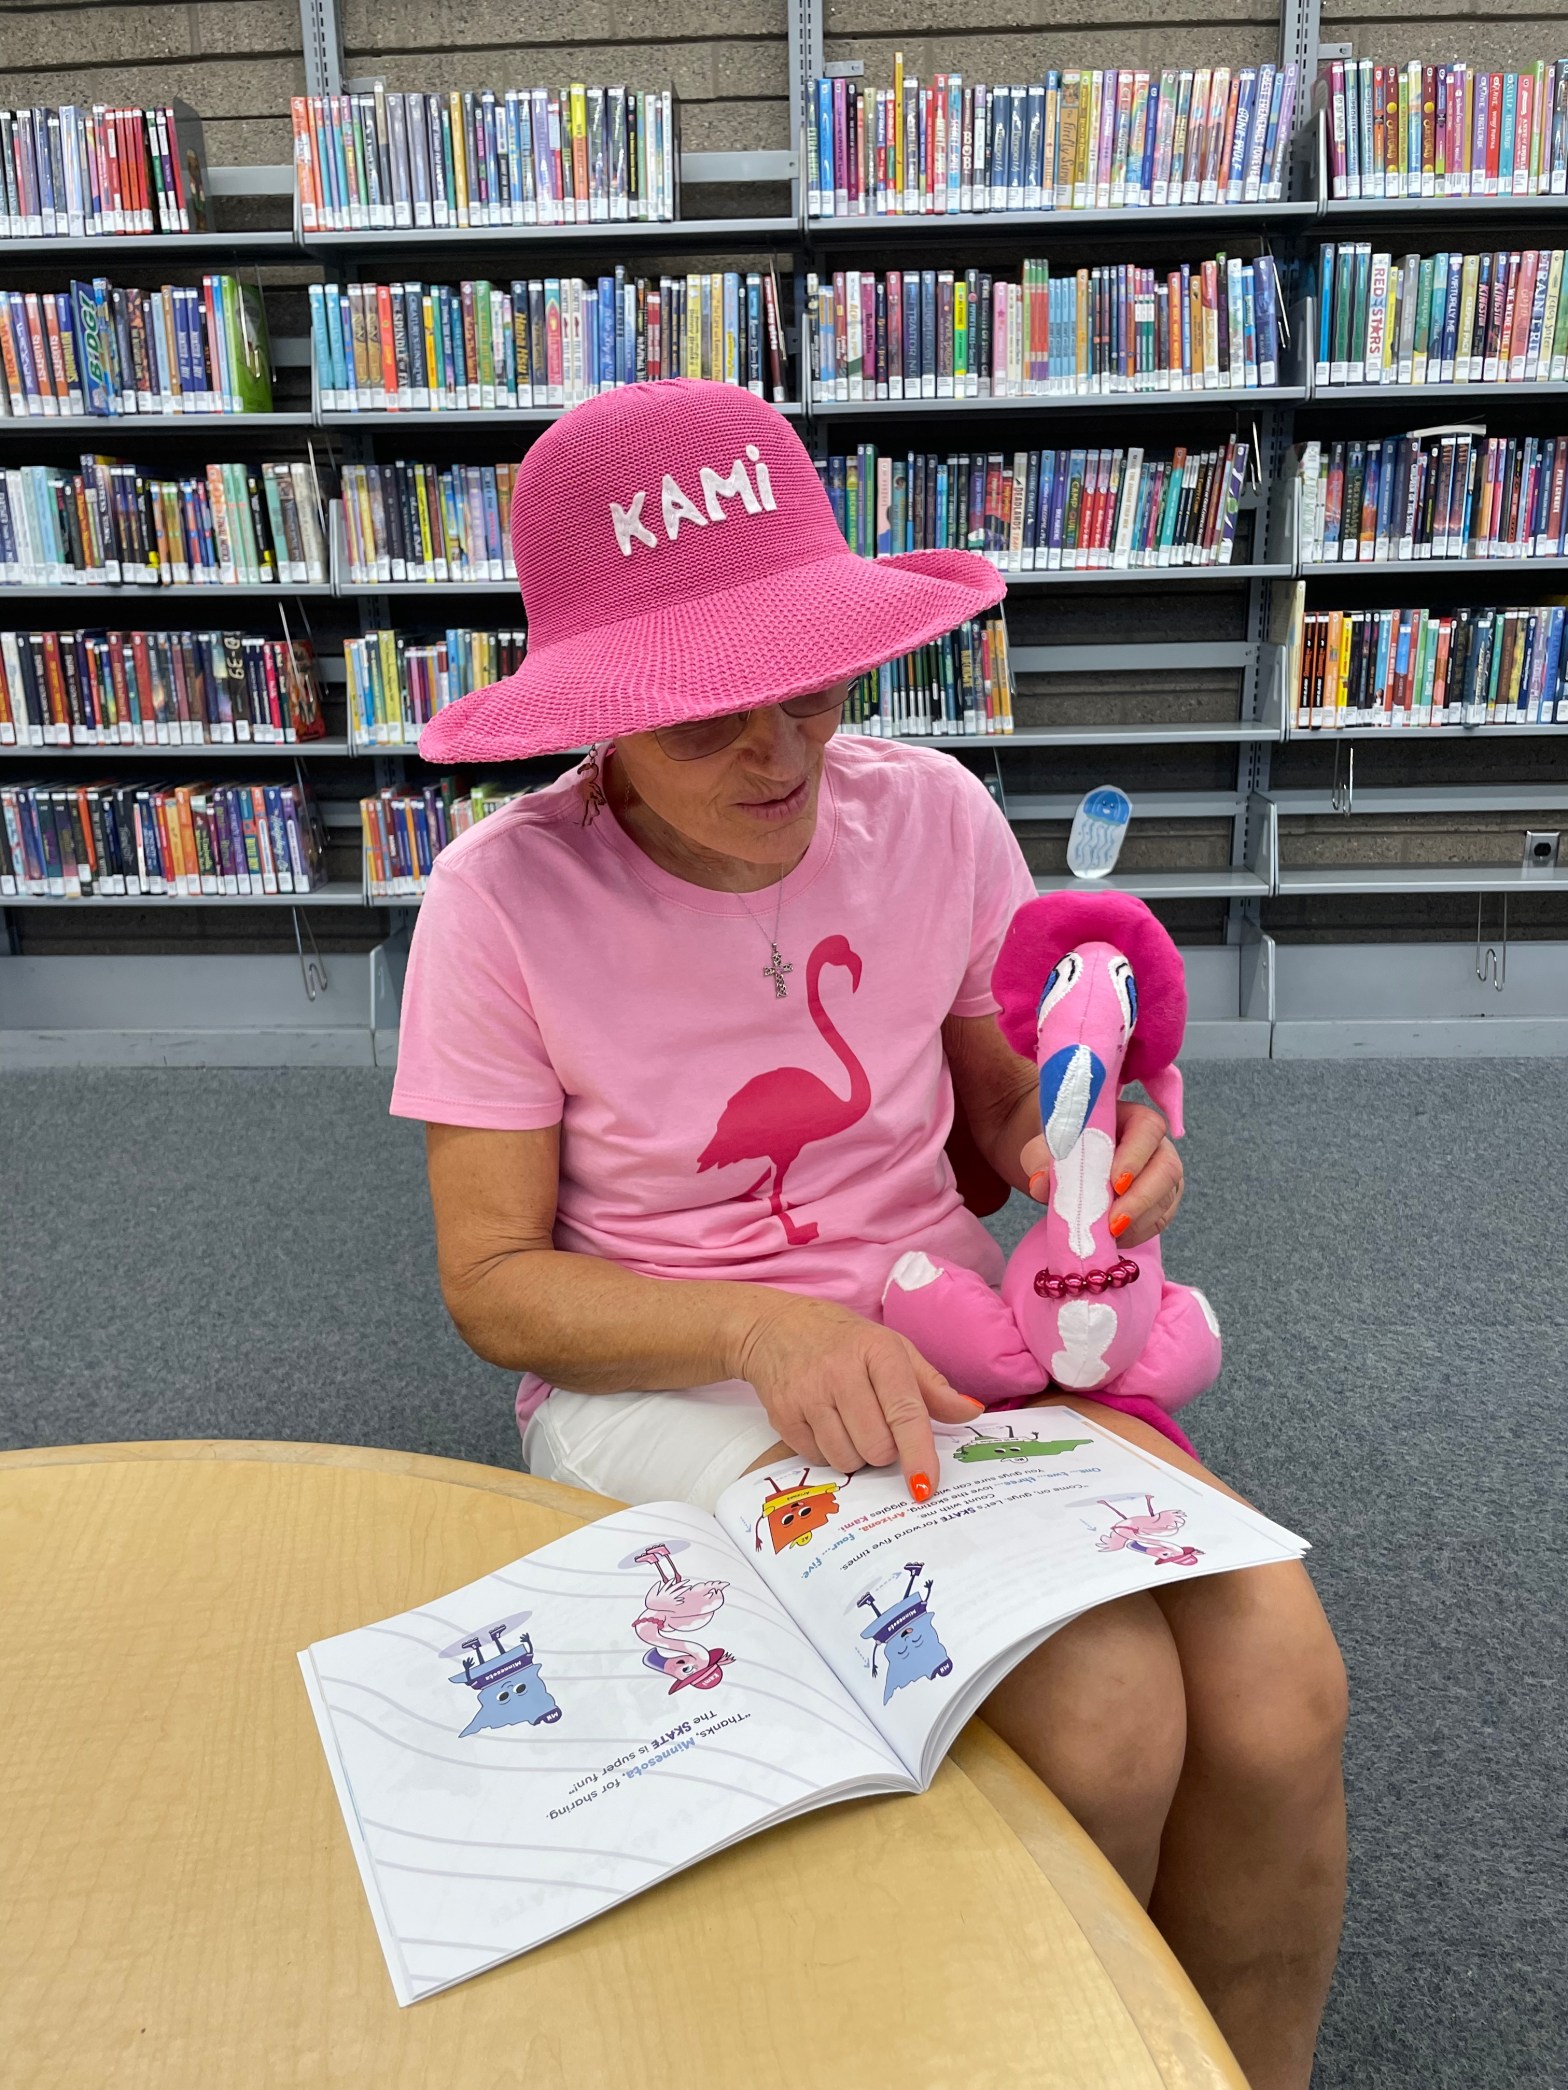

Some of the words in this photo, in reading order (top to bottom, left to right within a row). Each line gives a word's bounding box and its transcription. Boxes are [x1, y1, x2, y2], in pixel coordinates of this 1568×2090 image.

[1260, 76, 1272, 97] BEST
[1235, 108, 1249, 139] GONE
[1255, 99, 1269, 143] FRENEMIES
[1061, 122, 1076, 155] Firefly
[1232, 140, 1245, 171] WOLF
[1251, 146, 1262, 176] FOREVE
[1060, 157, 1074, 185] Summ
[1373, 268, 1385, 297] RED
[1449, 275, 1459, 318] VIRTUALLY
[1478, 284, 1489, 327] KINGSTON
[1494, 283, 1504, 325] KINGSTON
[1507, 288, 1515, 302] WE
[1447, 320, 1455, 333] ME
[1504, 303, 1513, 327] WERE
[394, 313, 405, 361] SPINDLE
[515, 313, 526, 347] Hana
[907, 310, 917, 355] TRAITOR
[517, 349, 528, 373] Hsu
[399, 372, 408, 389] FA
[1070, 481, 1080, 508] CAMP
[1013, 487, 1023, 530] DEADLANDS
[1067, 512, 1078, 548] QUILTB
[224, 637, 245, 680] D-39
[973, 1475, 995, 1486] sure
[997, 1468, 1022, 1480] guys
[950, 1490, 969, 1502] the
[951, 1481, 971, 1492] can
[1003, 1489, 1032, 1503] guys.
[1032, 1488, 1050, 1496] on,
[868, 1499, 907, 1519] giggles
[905, 1496, 949, 1516] skating,
[938, 1501, 961, 1515] with
[962, 1491, 995, 1507] Count
[976, 1497, 1003, 1511] Let's
[836, 1514, 868, 1533] Kami.
[916, 1508, 937, 1520] me.
[938, 1505, 976, 1524] SKATE
[893, 1517, 938, 1540] forward
[871, 1536, 892, 1551] five
[838, 1547, 870, 1572] times.
[885, 1607, 917, 1632] Minnesota
[484, 1659, 522, 1681] Minnesota
[545, 1711, 558, 1721] MN
[691, 1707, 717, 1727] The
[649, 1720, 692, 1750] SKATE
[598, 1750, 636, 1777] super
[599, 1777, 621, 1795] for
[544, 1789, 599, 1824] sharing.
